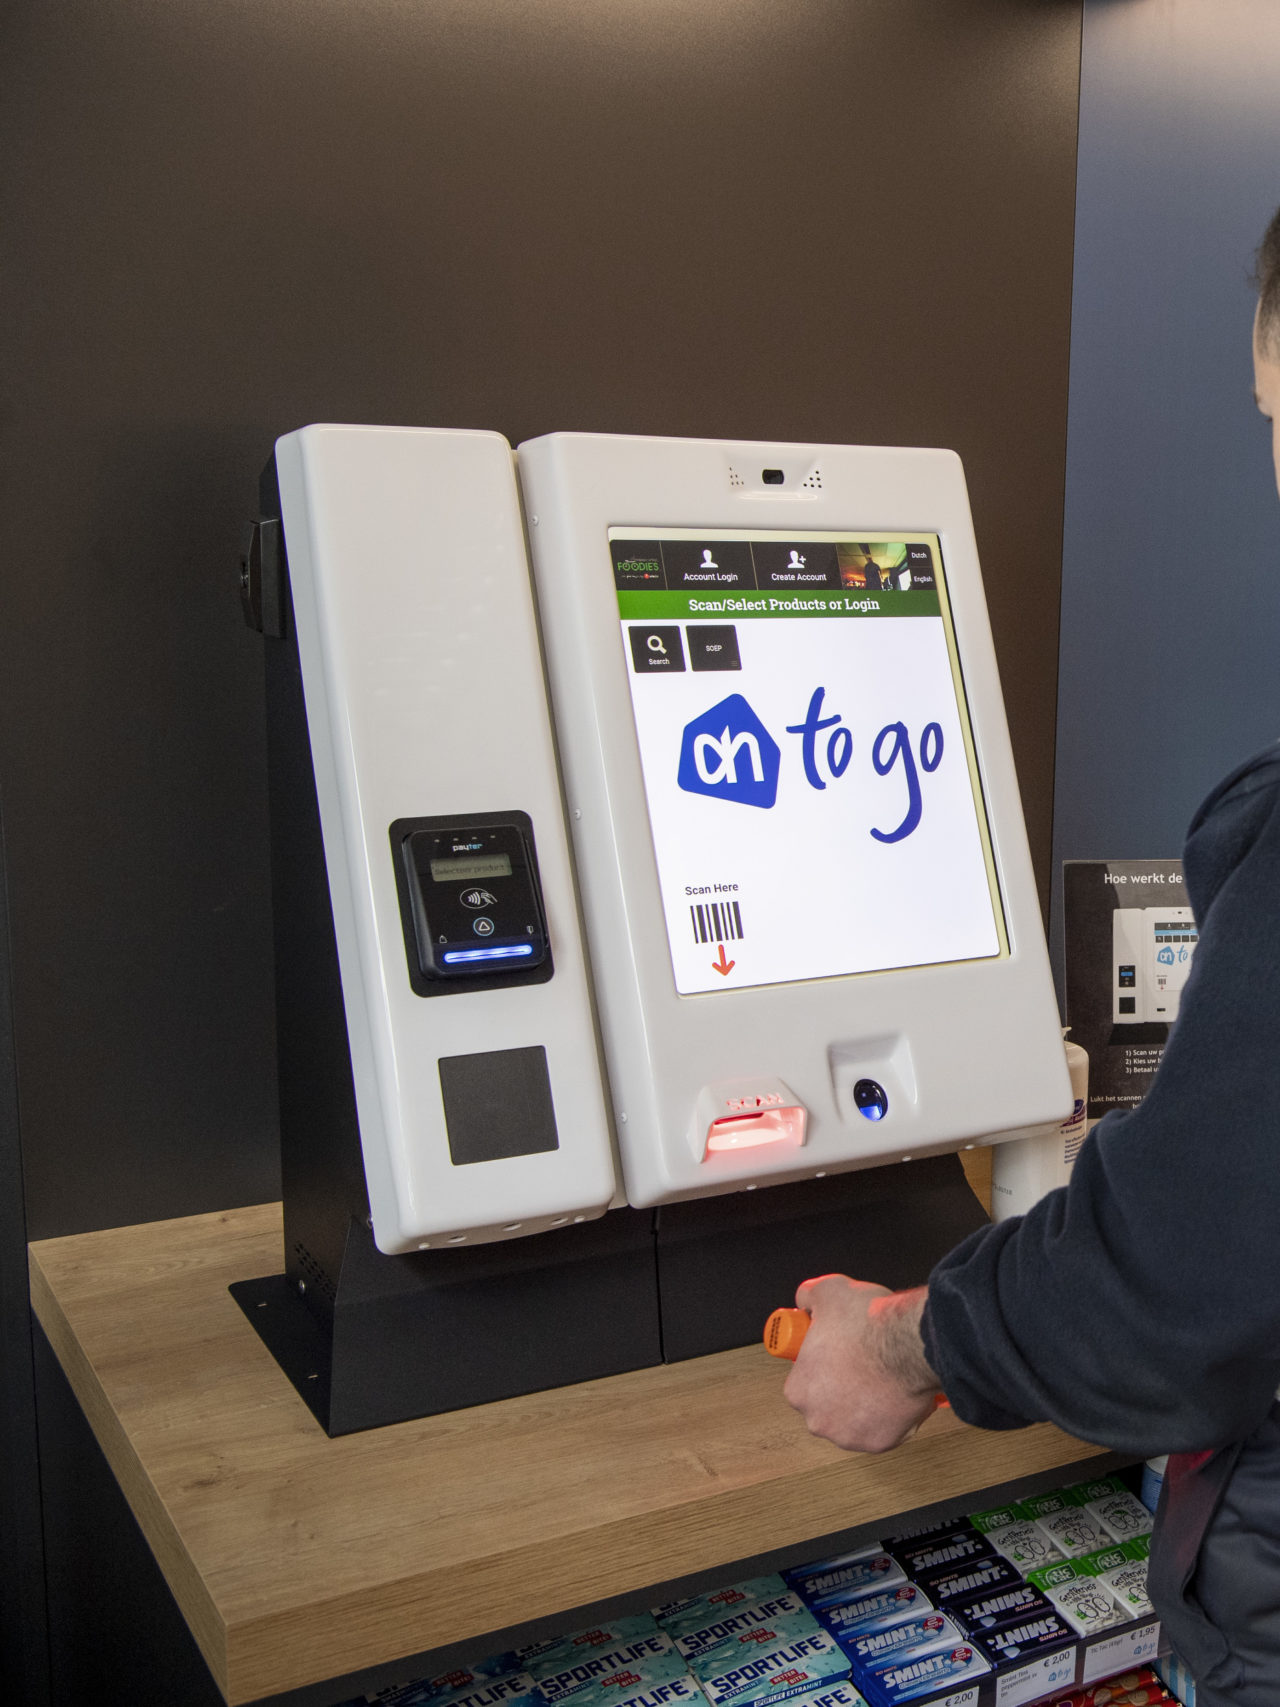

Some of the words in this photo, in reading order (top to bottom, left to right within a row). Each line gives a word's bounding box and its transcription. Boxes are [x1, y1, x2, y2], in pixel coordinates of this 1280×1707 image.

[617, 561, 660, 572] FOODIES
[683, 572, 714, 581] Account
[716, 572, 738, 583] Login
[771, 572, 796, 581] Create
[797, 573, 827, 581] Account
[913, 575, 933, 584] English
[688, 597, 767, 612] Scan/Select
[768, 598, 828, 611] Products
[830, 601, 843, 611] or
[845, 598, 880, 612] Login
[648, 657, 670, 666] Search
[786, 686, 853, 790] to
[870, 721, 944, 844] go
[1104, 873, 1127, 884] Hoe
[1130, 872, 1165, 884] werkt
[1168, 873, 1183, 884] de
[685, 884, 711, 896] Scan
[714, 882, 739, 894] Here
[726, 1092, 784, 1111] SCAN
[912, 1540, 976, 1572] SMINT
[805, 1564, 865, 1594] SMINT
[938, 1565, 1002, 1599] SMINT
[829, 1594, 889, 1625] SMINT
[971, 1586, 1035, 1620] SMINT
[682, 1595, 794, 1651] SPORTLIFE
[741, 1628, 765, 1643] BETTER
[758, 1632, 775, 1644] BITE!
[856, 1623, 917, 1656] SMINT
[995, 1616, 1060, 1651] SMINT
[1130, 1632, 1137, 1641] €
[1138, 1626, 1155, 1639] 1,95
[693, 1638, 729, 1658] EXTRAMINT
[541, 1638, 664, 1695] SPORTLIFE
[711, 1633, 826, 1694] SPORTLIFE
[1043, 1659, 1050, 1668] €
[1052, 1650, 1071, 1665] 2,00
[604, 1671, 630, 1686] BETTER
[772, 1669, 797, 1685] BETTER
[790, 1673, 806, 1685] BITE!
[883, 1654, 945, 1689] SMINT
[621, 1675, 639, 1687] BITE!
[724, 1680, 760, 1700] EXTRAMINT
[552, 1682, 593, 1701] EXTRAMINT
[754, 1691, 785, 1707] SPORTLIFE
[786, 1680, 823, 1697] EXTRAMINT
[945, 1699, 951, 1707] €
[953, 1690, 973, 1705] 2,00
